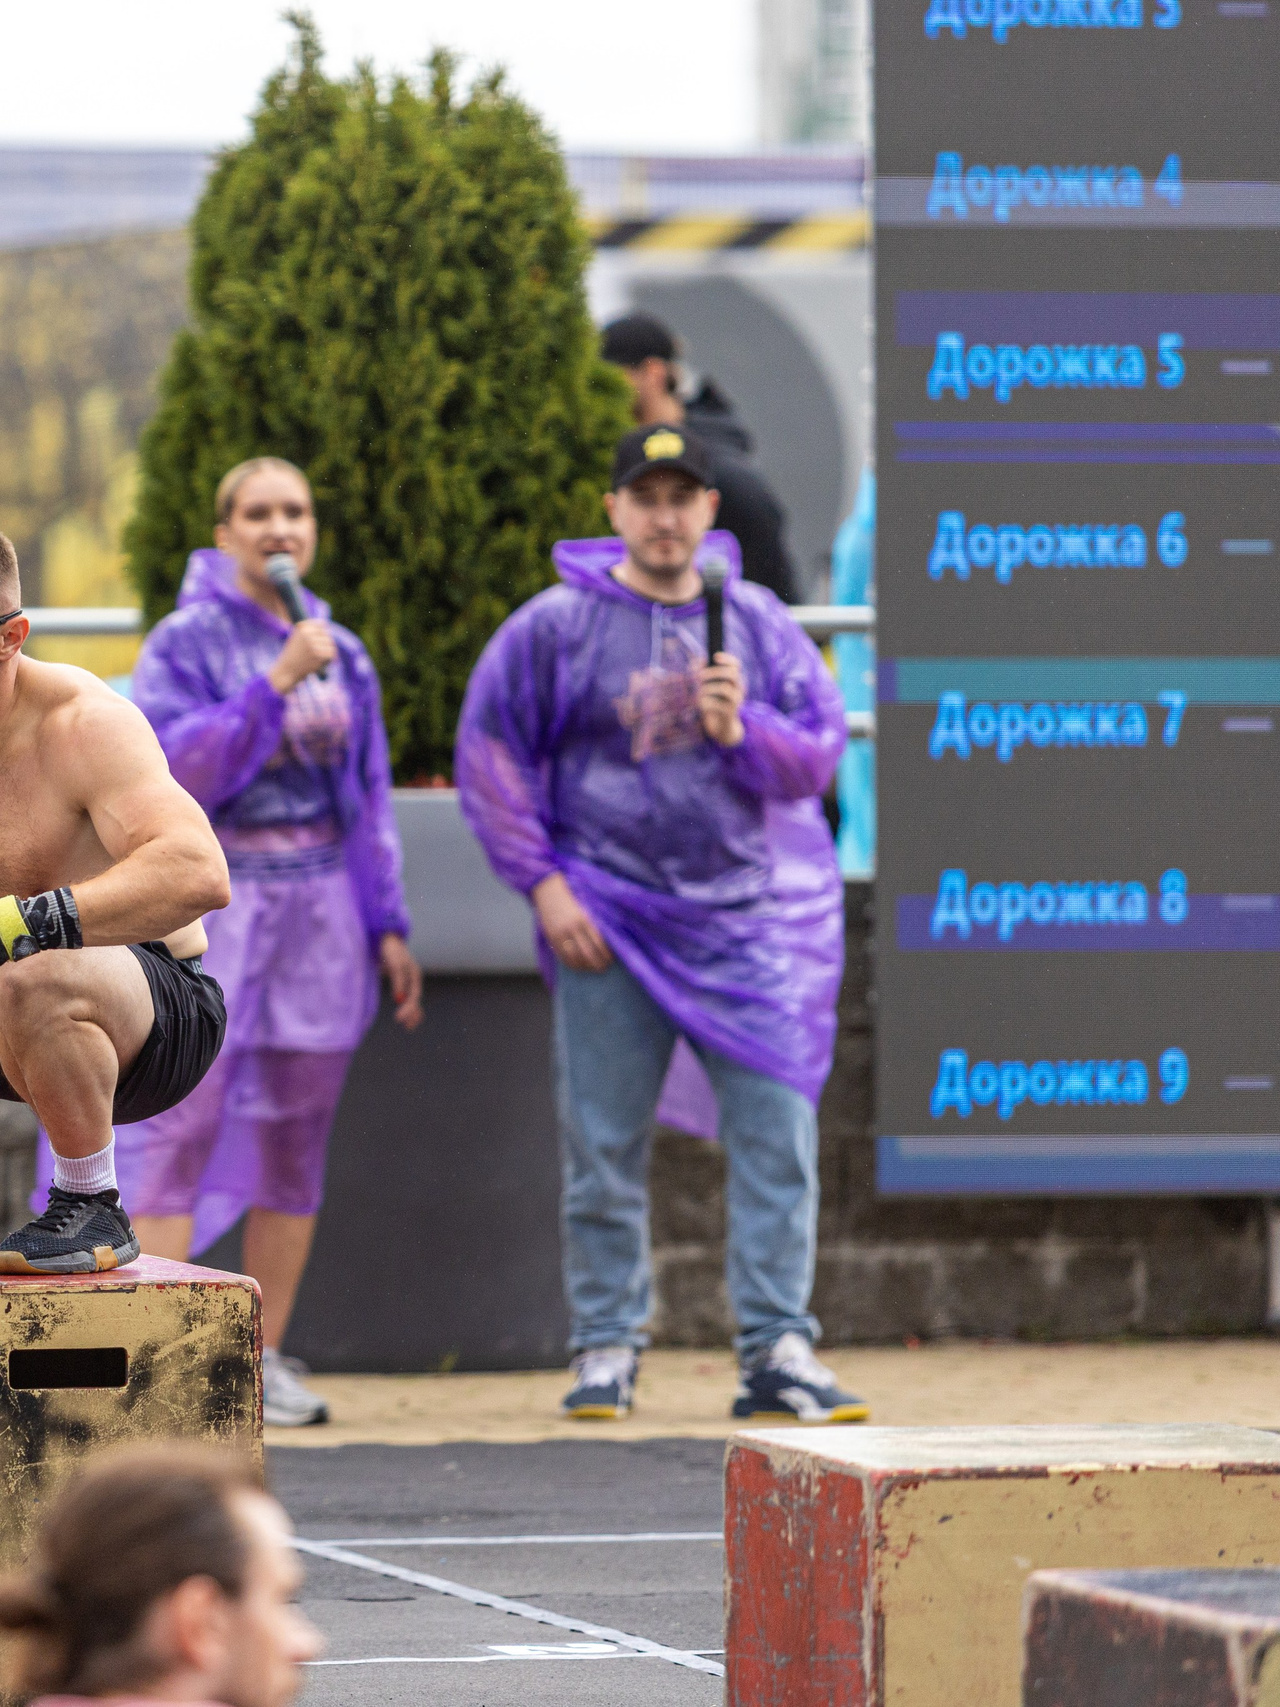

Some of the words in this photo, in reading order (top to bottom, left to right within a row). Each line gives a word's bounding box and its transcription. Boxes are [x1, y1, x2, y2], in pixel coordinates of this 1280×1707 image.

[926, 151, 1144, 222] Дорожка
[1154, 153, 1183, 207] 4
[926, 331, 1147, 403] Дорожка
[1156, 332, 1185, 389] 5
[927, 510, 1147, 584] Дорожка
[1156, 511, 1188, 568] 6
[928, 690, 1148, 762] Дорожка
[1157, 690, 1188, 747] 7
[929, 868, 1148, 943] Дорожка
[1158, 868, 1189, 925] 8
[929, 1048, 1149, 1121] Дорожка
[1158, 1047, 1189, 1104] 9
